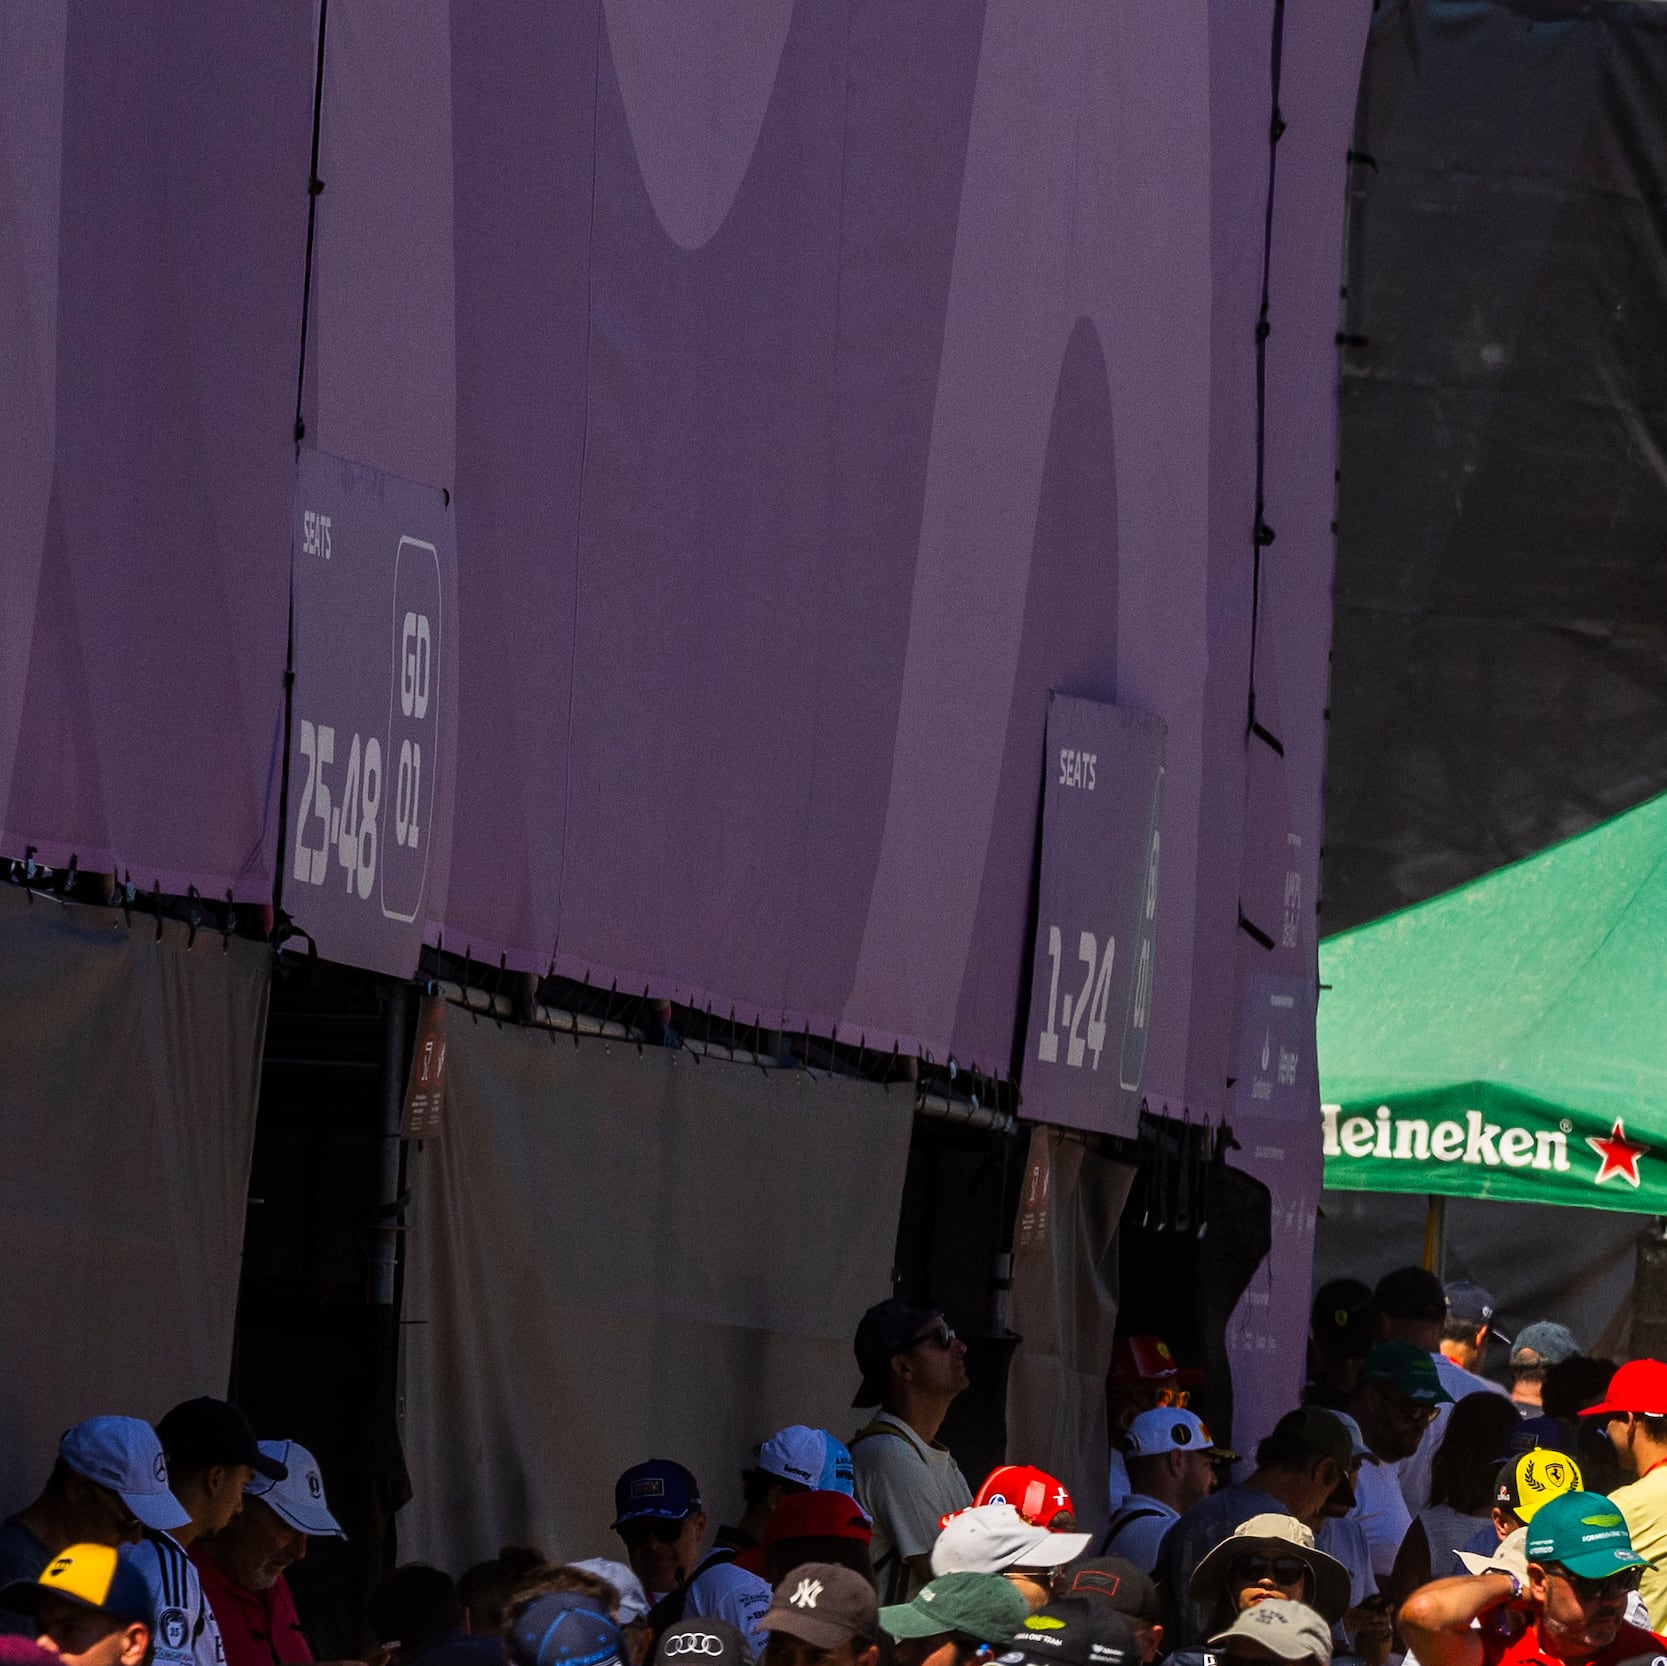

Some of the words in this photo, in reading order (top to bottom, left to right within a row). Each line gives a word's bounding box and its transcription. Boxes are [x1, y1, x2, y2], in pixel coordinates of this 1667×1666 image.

[303, 510, 332, 560] SEATS
[400, 611, 431, 719] GD
[293, 719, 382, 900] 25-48
[395, 739, 421, 849] 01
[1058, 748, 1098, 791] SEATS
[1037, 924, 1116, 1071] 1-24
